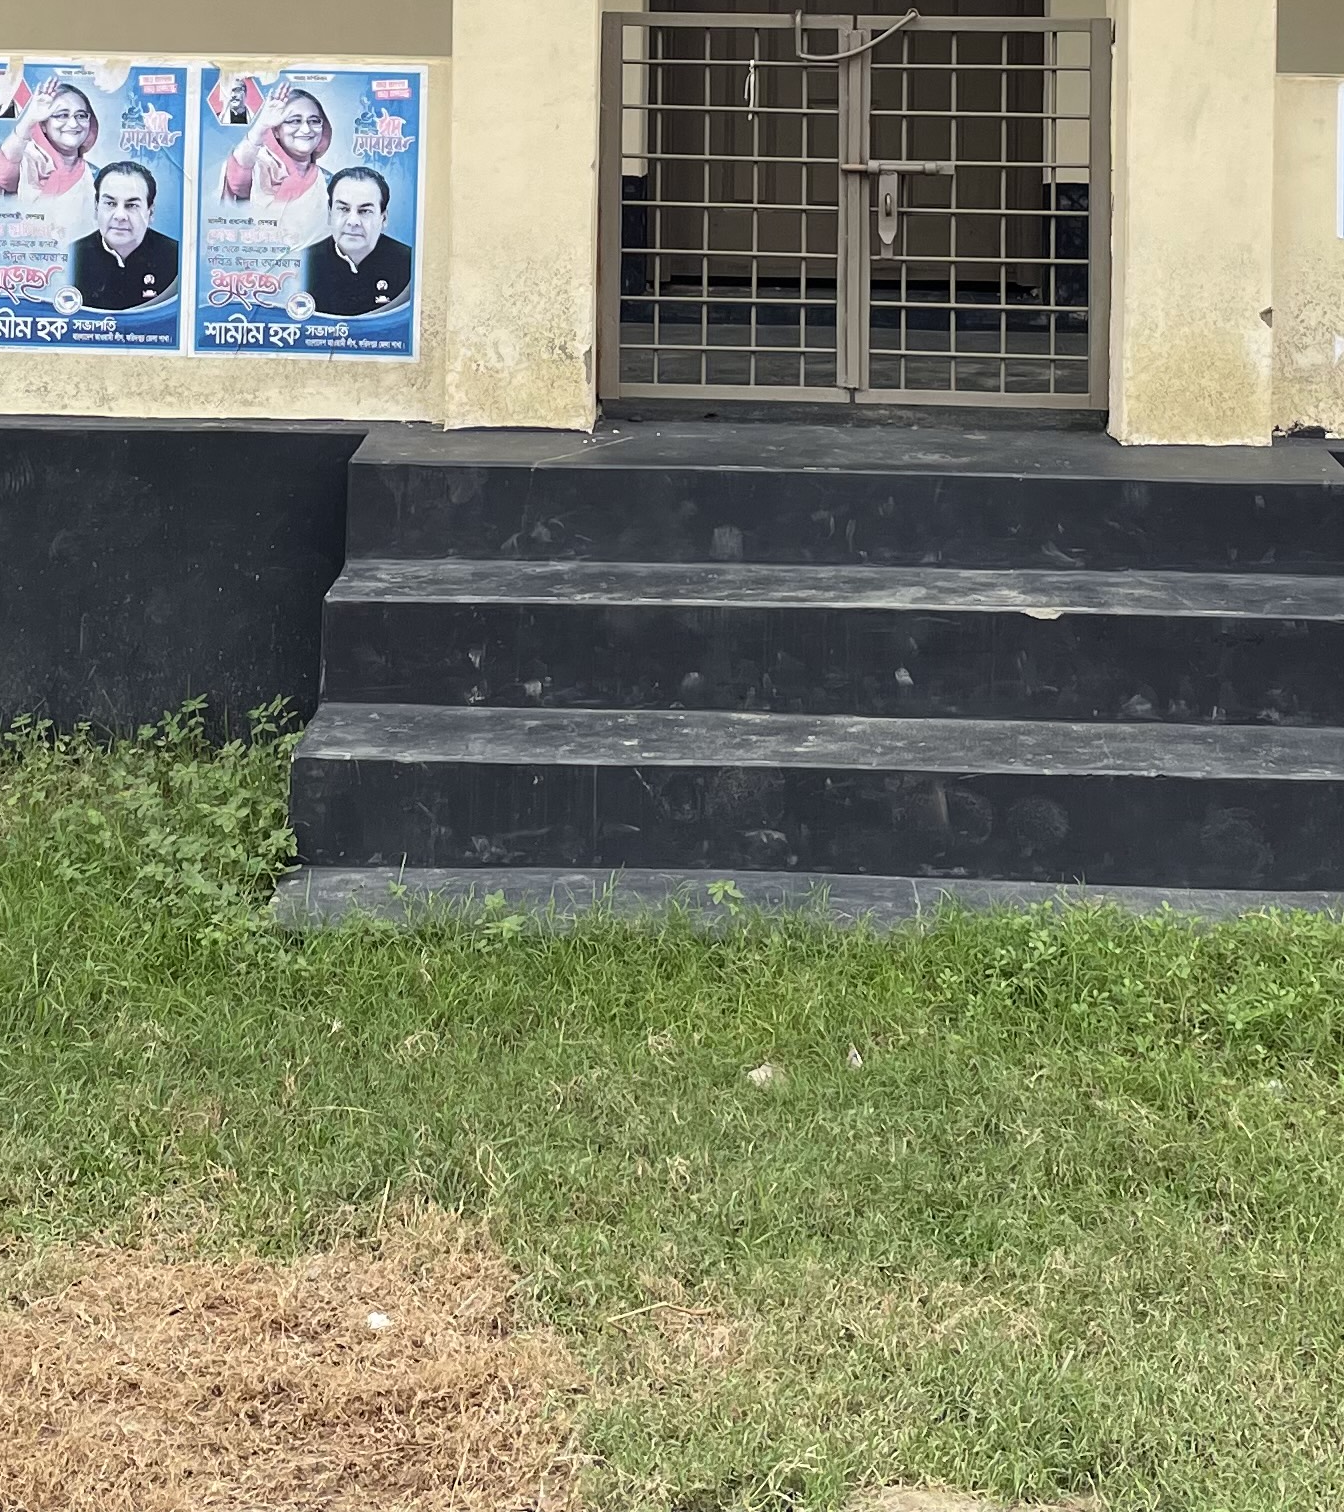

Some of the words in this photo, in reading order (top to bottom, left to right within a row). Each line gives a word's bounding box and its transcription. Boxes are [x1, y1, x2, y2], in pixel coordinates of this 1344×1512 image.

[36, 317, 69, 341] হক
[72, 317, 117, 332] সভাপতি
[204, 313, 265, 345] শামীম
[268, 323, 301, 347] হক
[305, 322, 349, 338] সভাপতি
